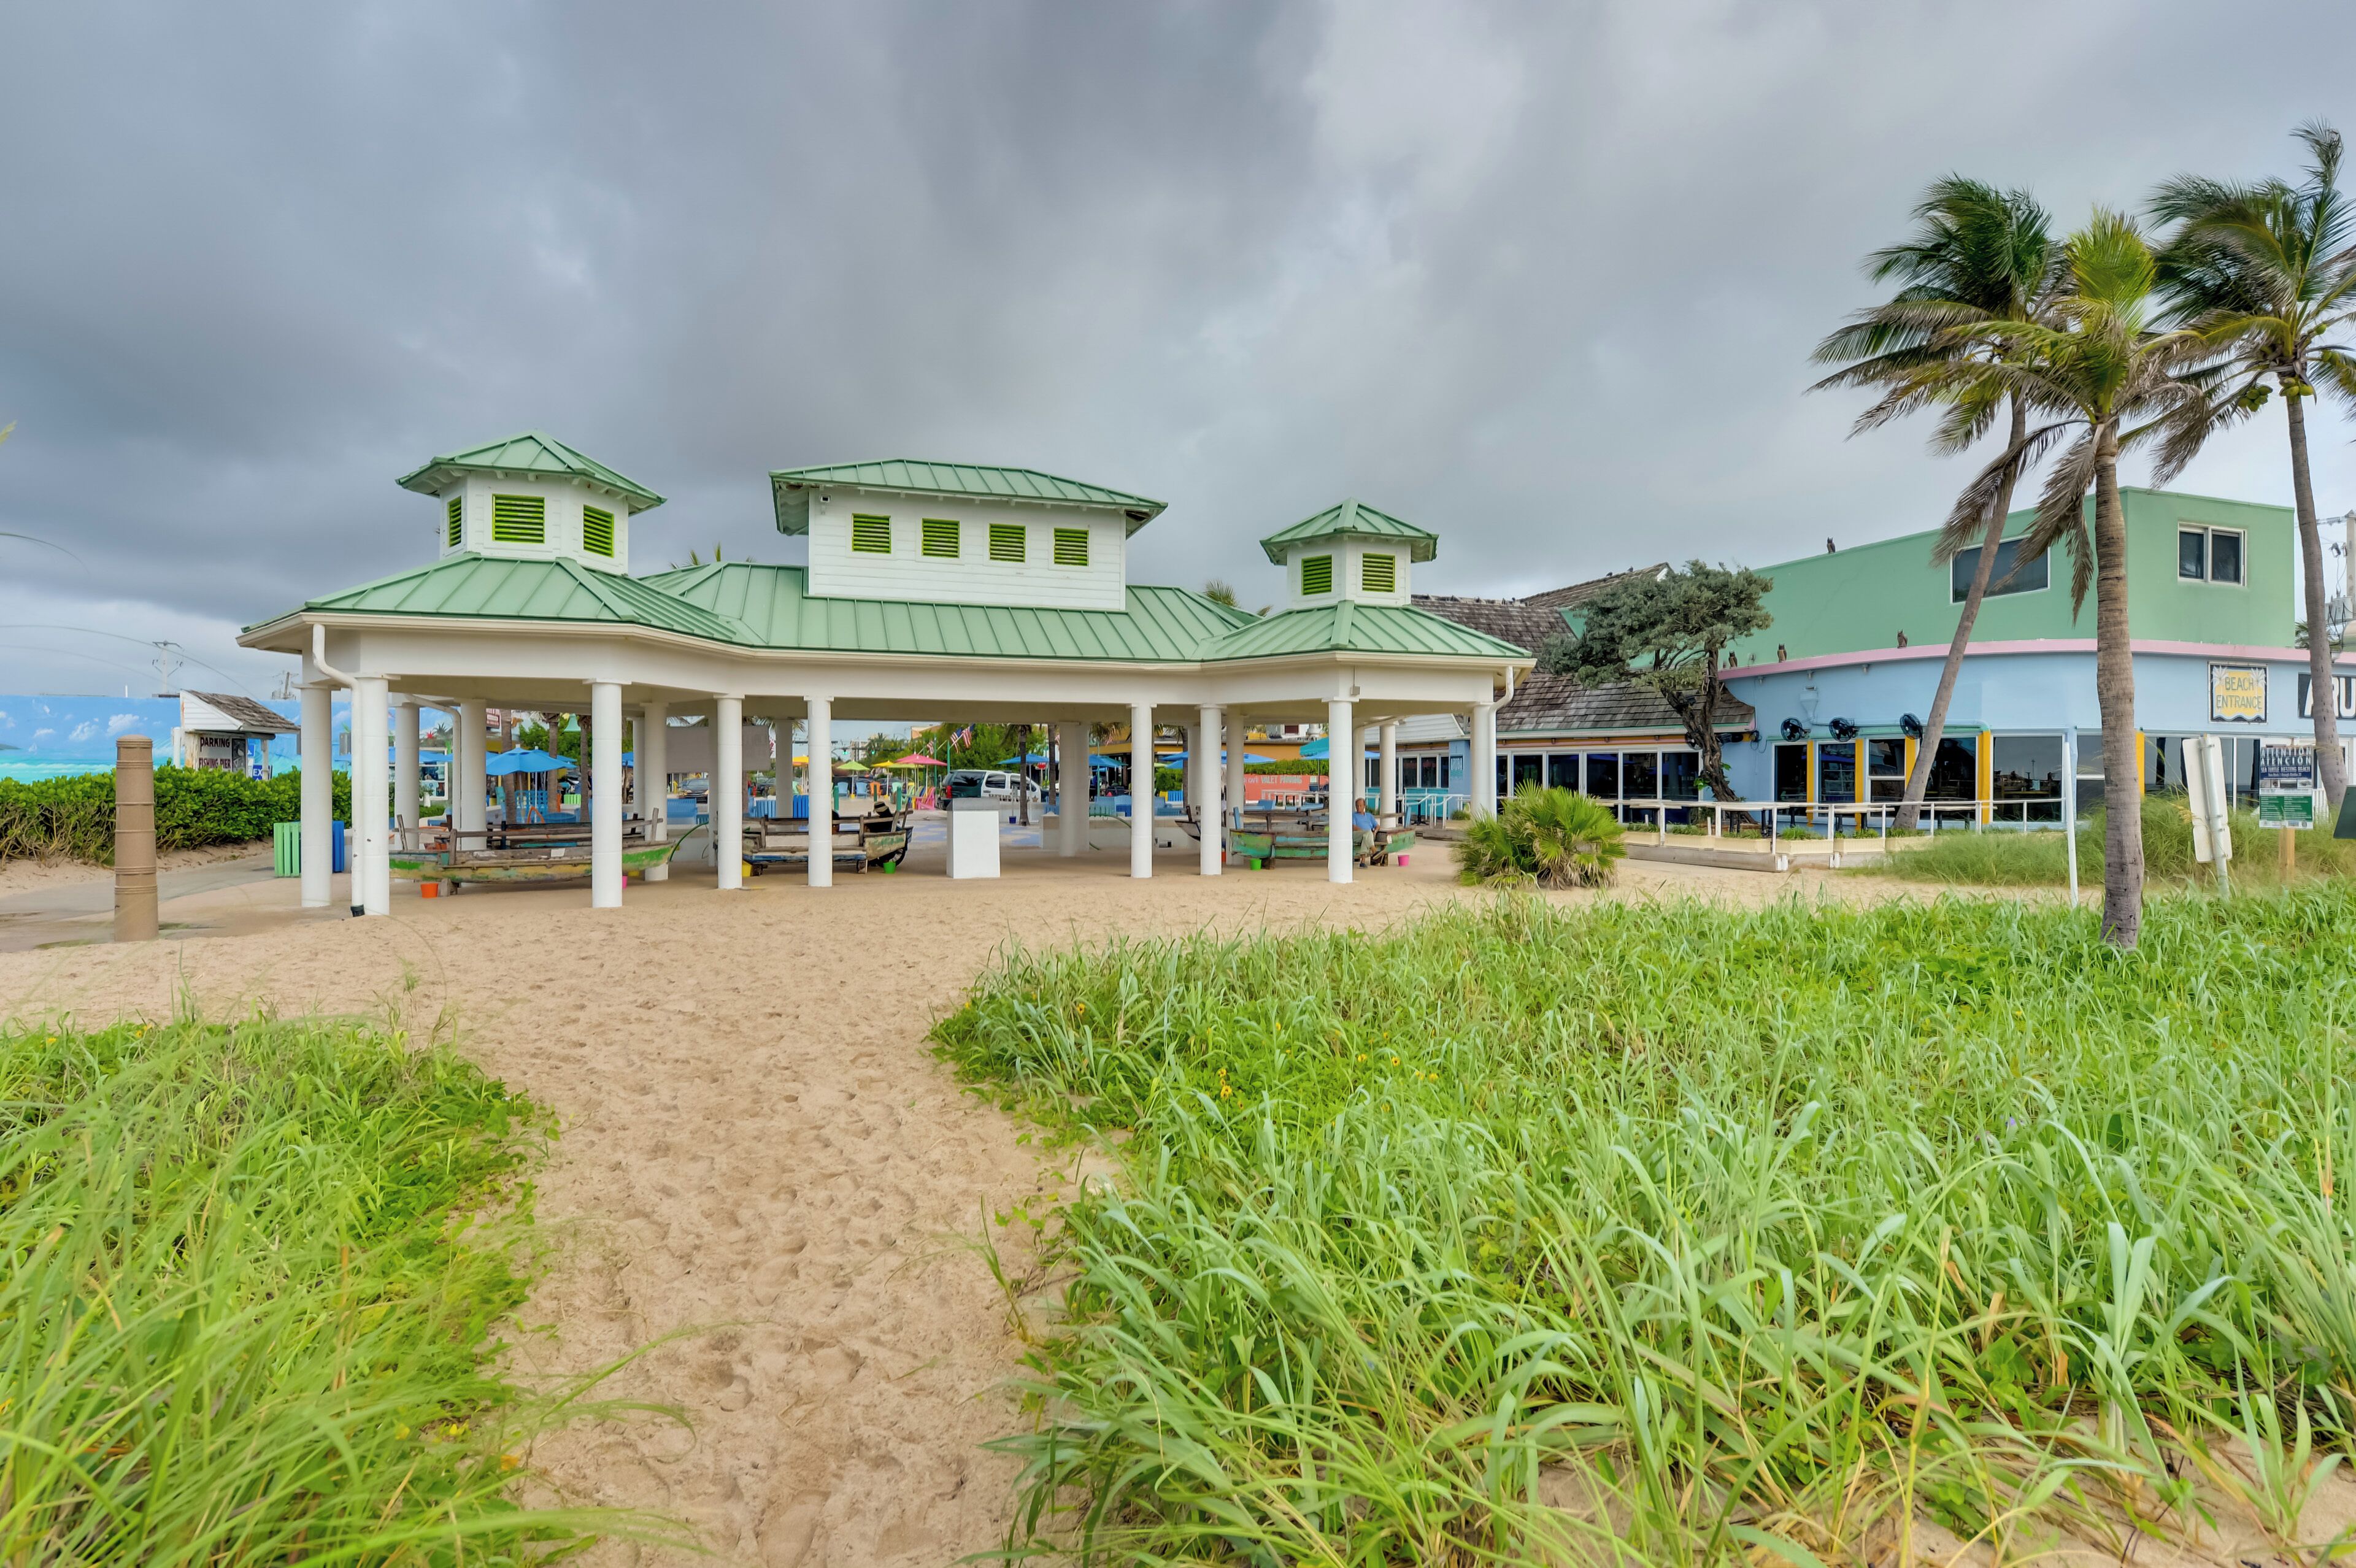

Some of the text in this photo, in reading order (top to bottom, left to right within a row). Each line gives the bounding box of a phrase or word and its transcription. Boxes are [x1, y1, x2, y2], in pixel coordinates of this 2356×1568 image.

[2225, 677, 2254, 691] BEACH
[2216, 694, 2262, 710] ENTRANCE
[200, 737, 230, 752] PARKING
[2261, 746, 2311, 758] ATTENTION
[199, 758, 231, 769] FISHING PIER
